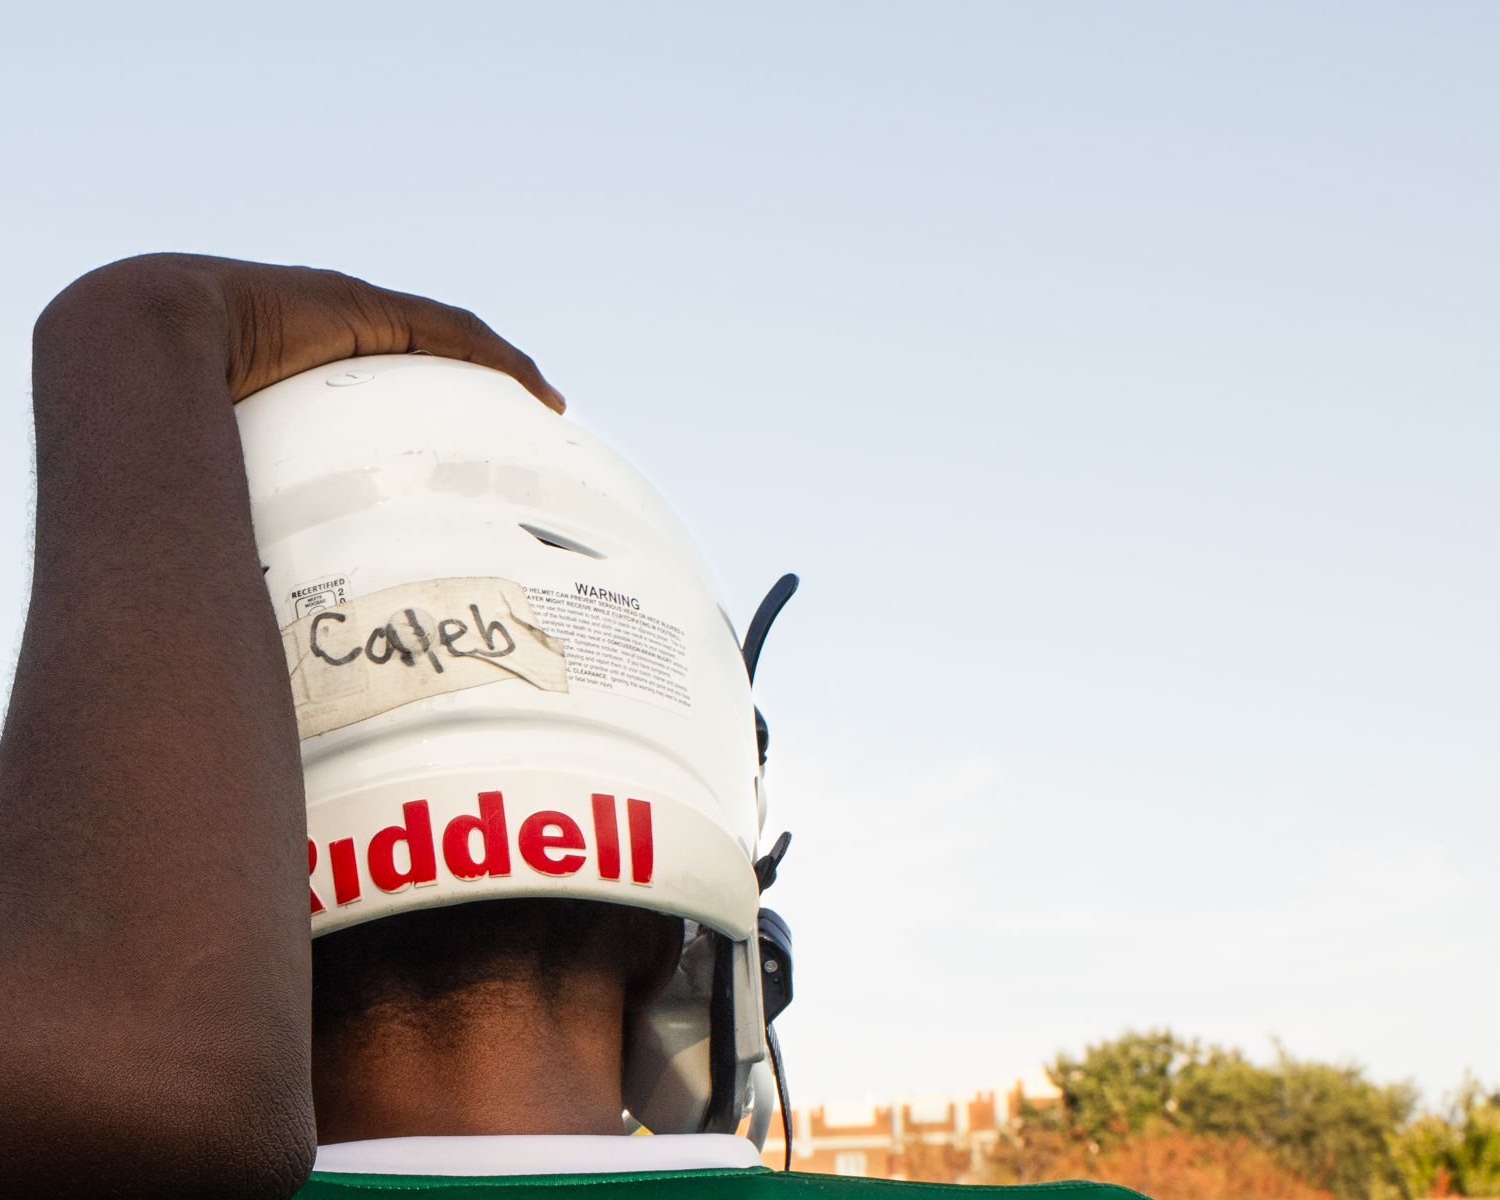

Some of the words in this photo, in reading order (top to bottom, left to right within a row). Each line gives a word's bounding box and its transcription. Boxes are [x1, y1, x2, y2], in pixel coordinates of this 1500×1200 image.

[291, 578, 345, 599] RECERTIFIED
[528, 586, 553, 596] HELMET
[555, 591, 568, 599] CAN
[574, 582, 640, 611] WARNING
[310, 603, 516, 674] Caleb
